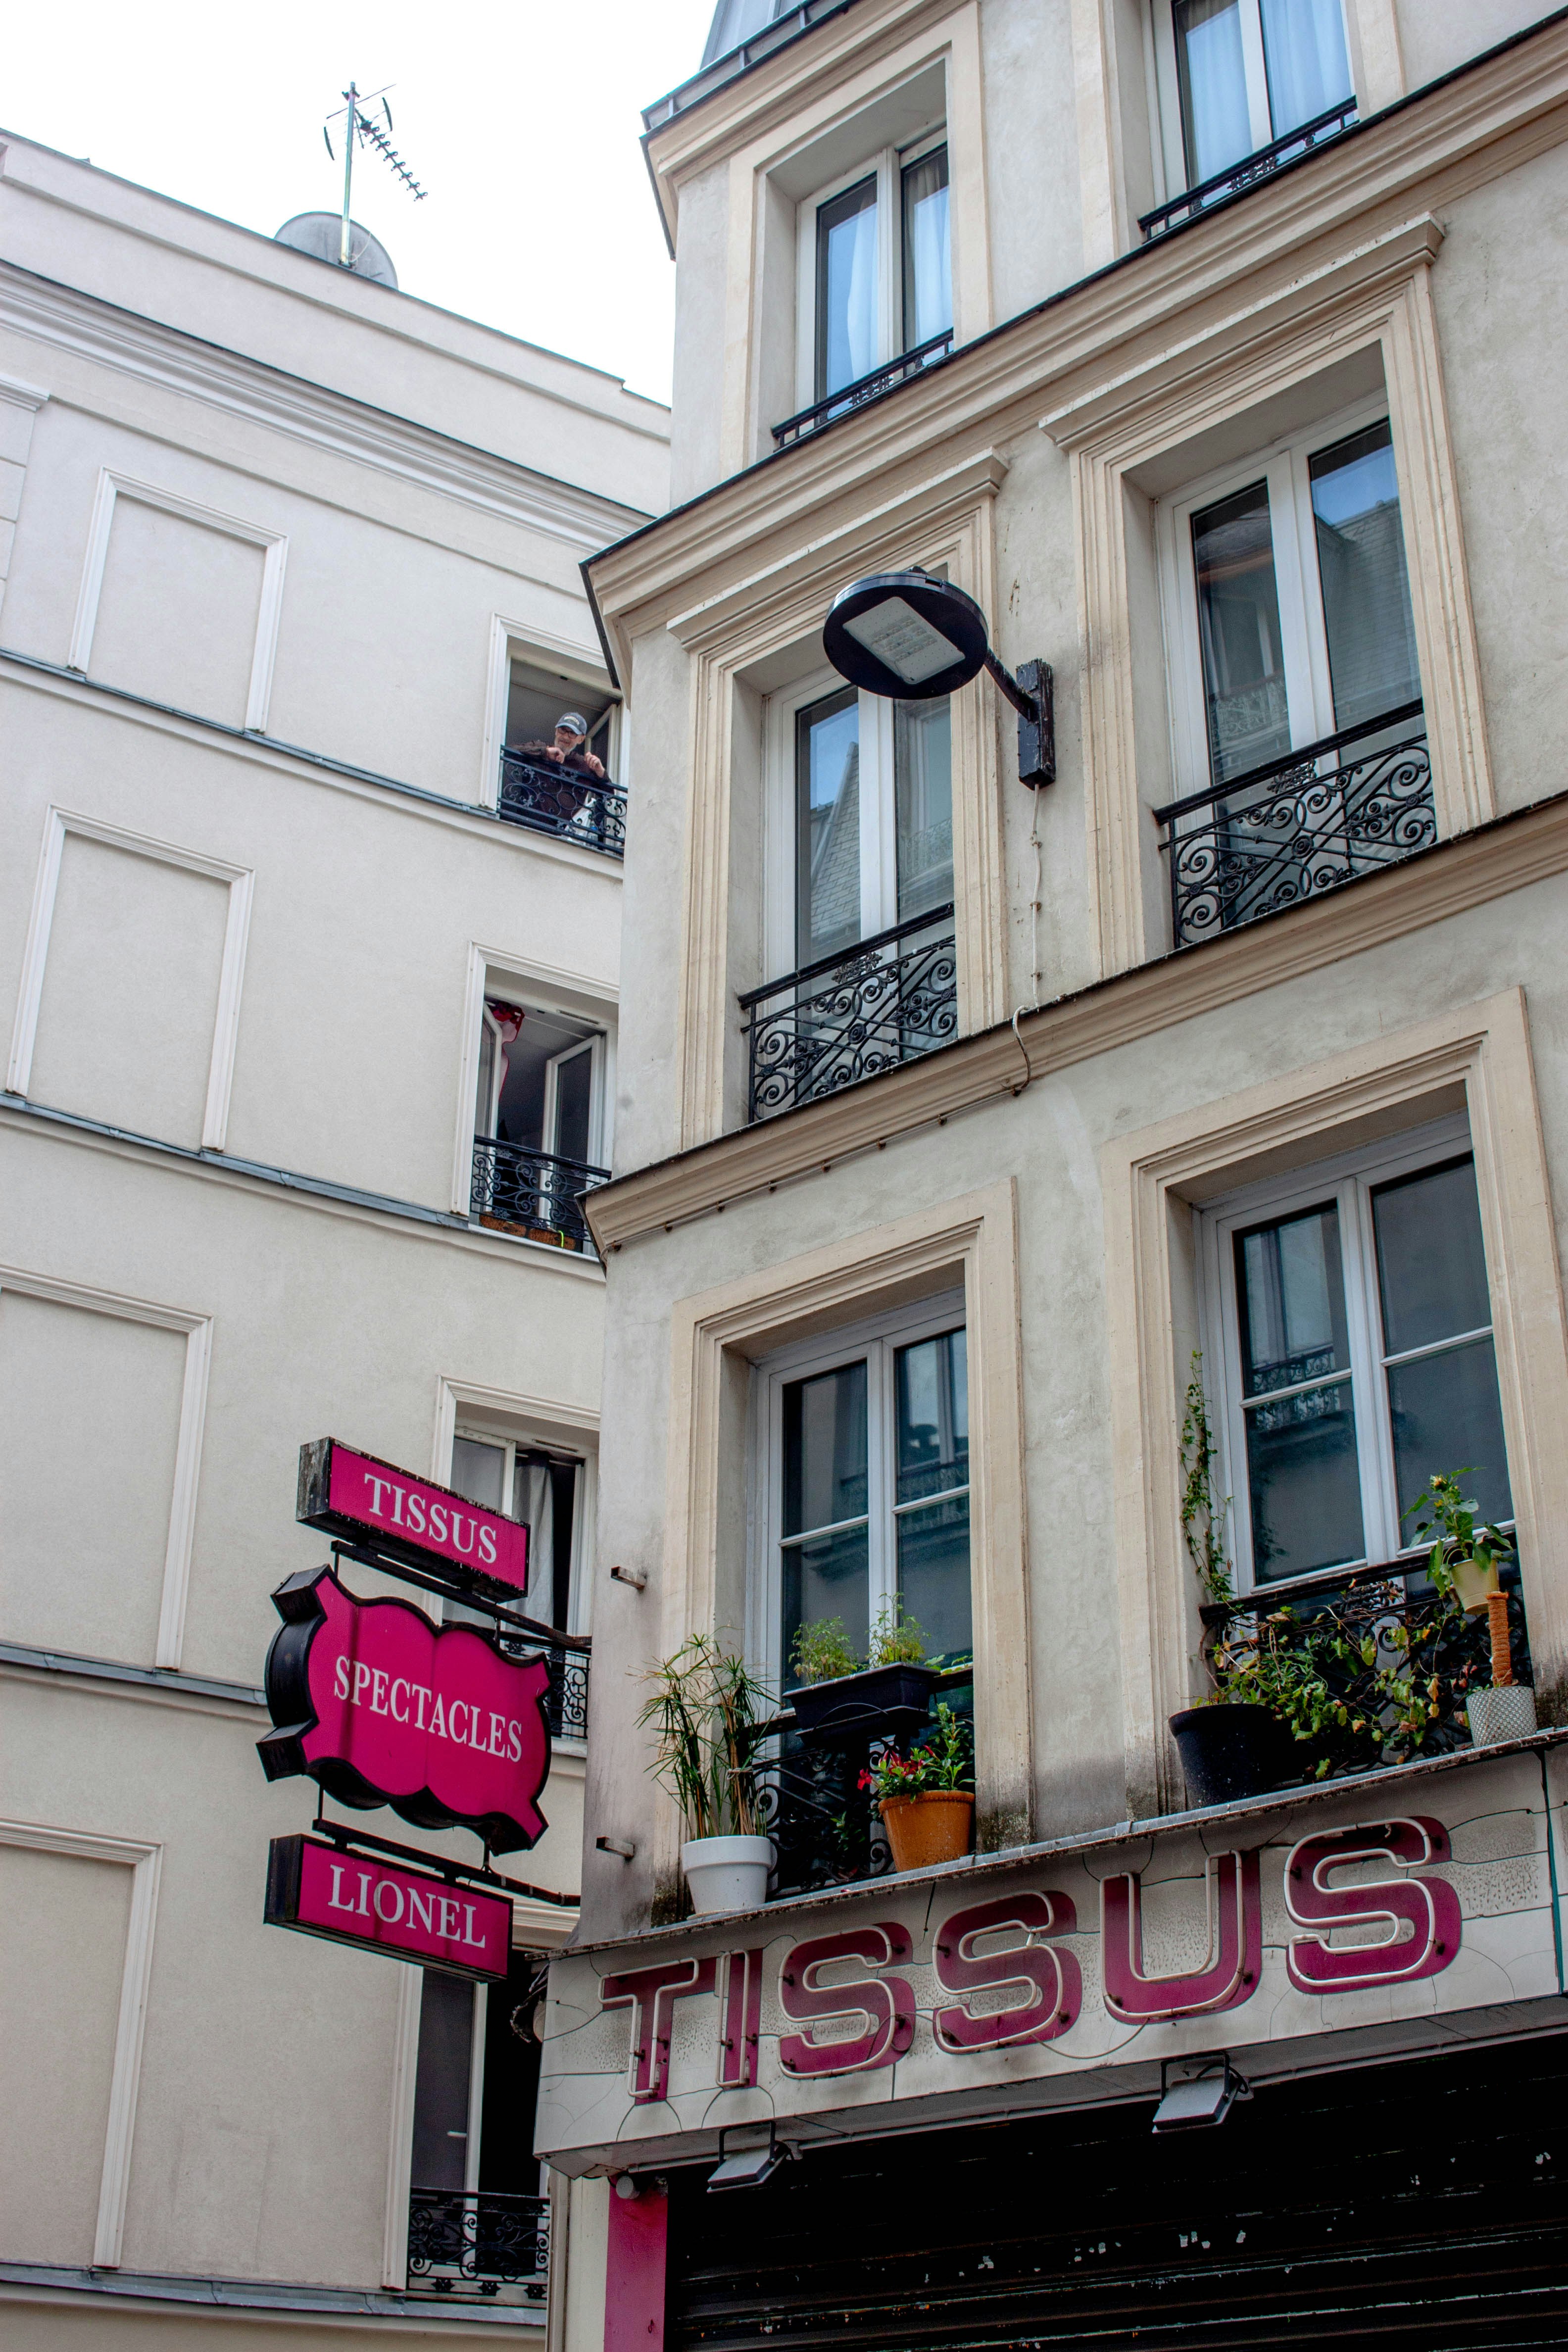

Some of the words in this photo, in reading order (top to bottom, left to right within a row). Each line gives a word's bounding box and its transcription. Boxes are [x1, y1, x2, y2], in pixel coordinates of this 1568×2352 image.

[364, 1473, 497, 1564] TISSUS
[334, 1656, 522, 1762] SPECTACLES
[328, 1864, 486, 1948] LIONEL
[597, 1815, 1463, 2105] TISSUS
